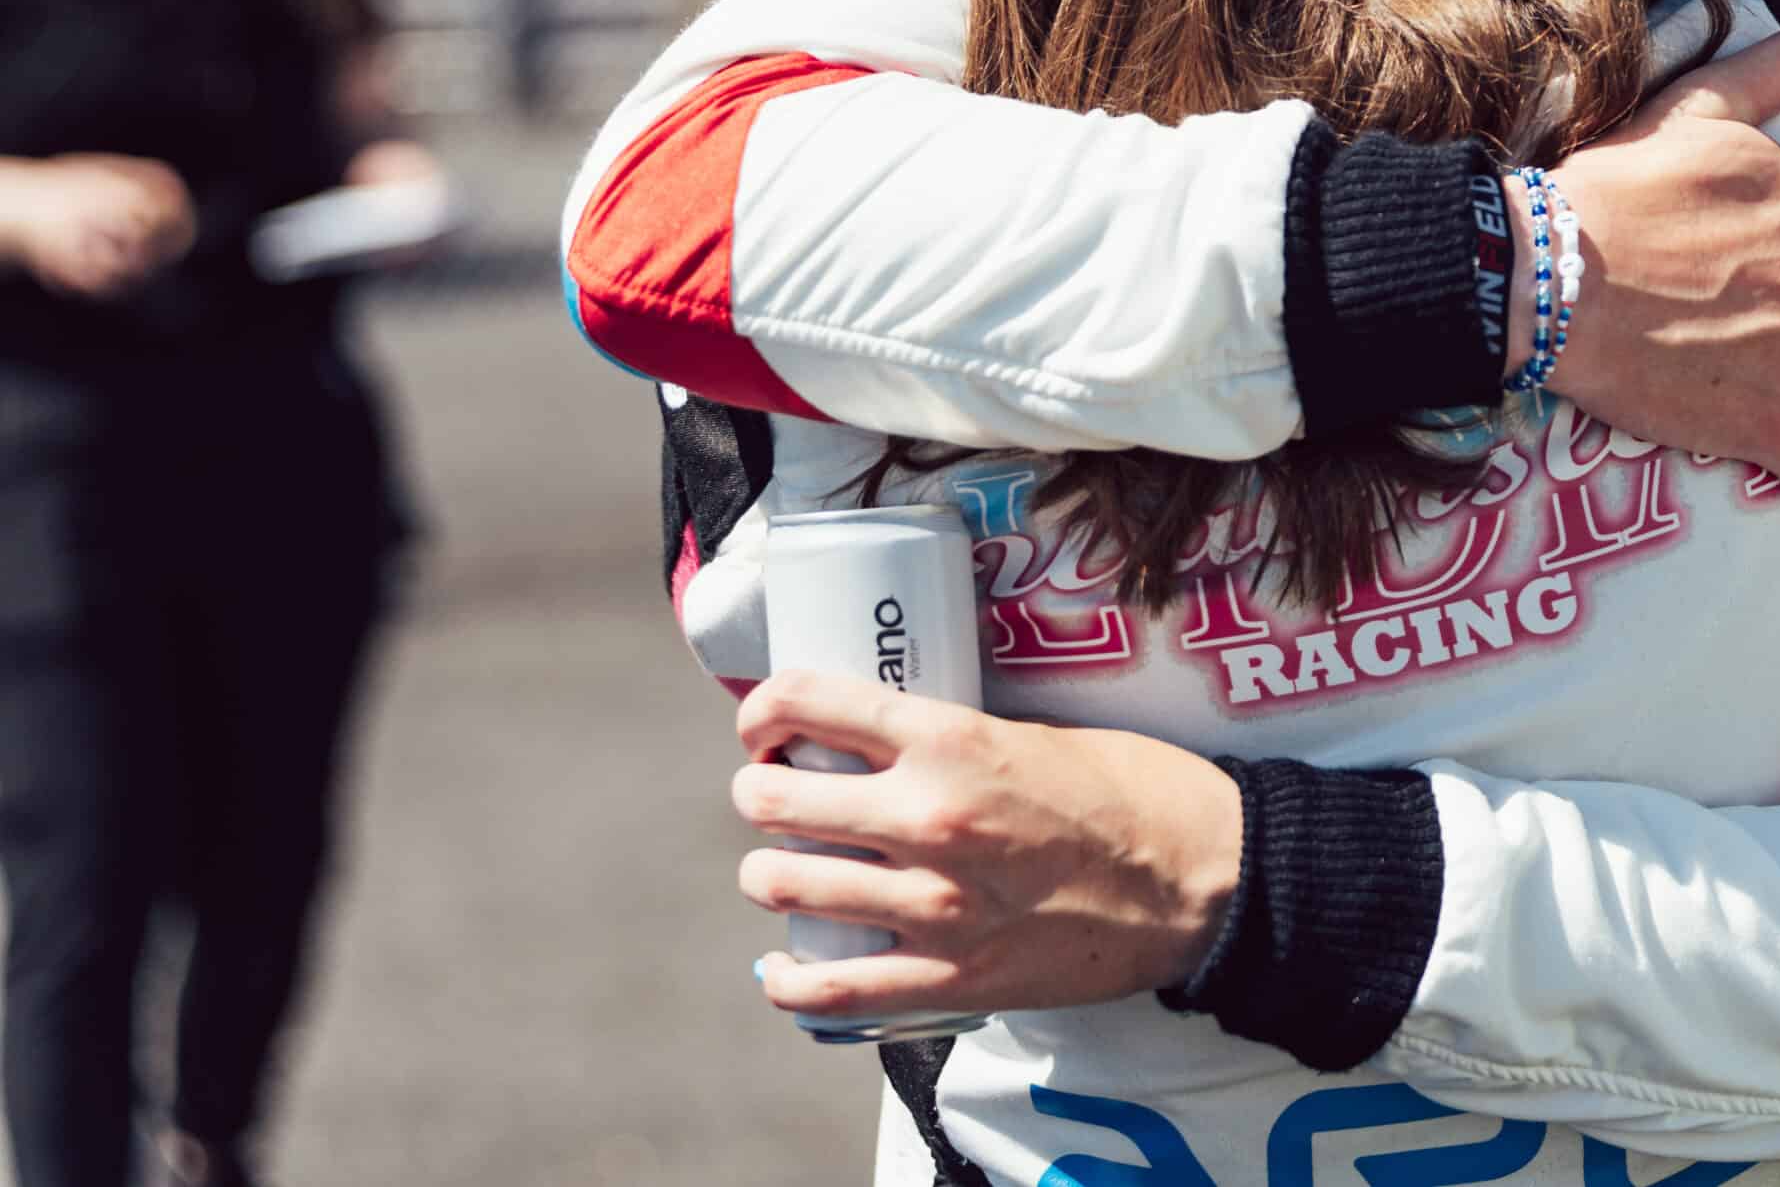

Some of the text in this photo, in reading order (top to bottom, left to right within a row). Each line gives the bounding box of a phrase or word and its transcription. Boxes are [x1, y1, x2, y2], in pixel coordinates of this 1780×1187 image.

[873, 596, 906, 694] ano
[907, 637, 922, 681] Water
[1221, 571, 1579, 705] RACING
